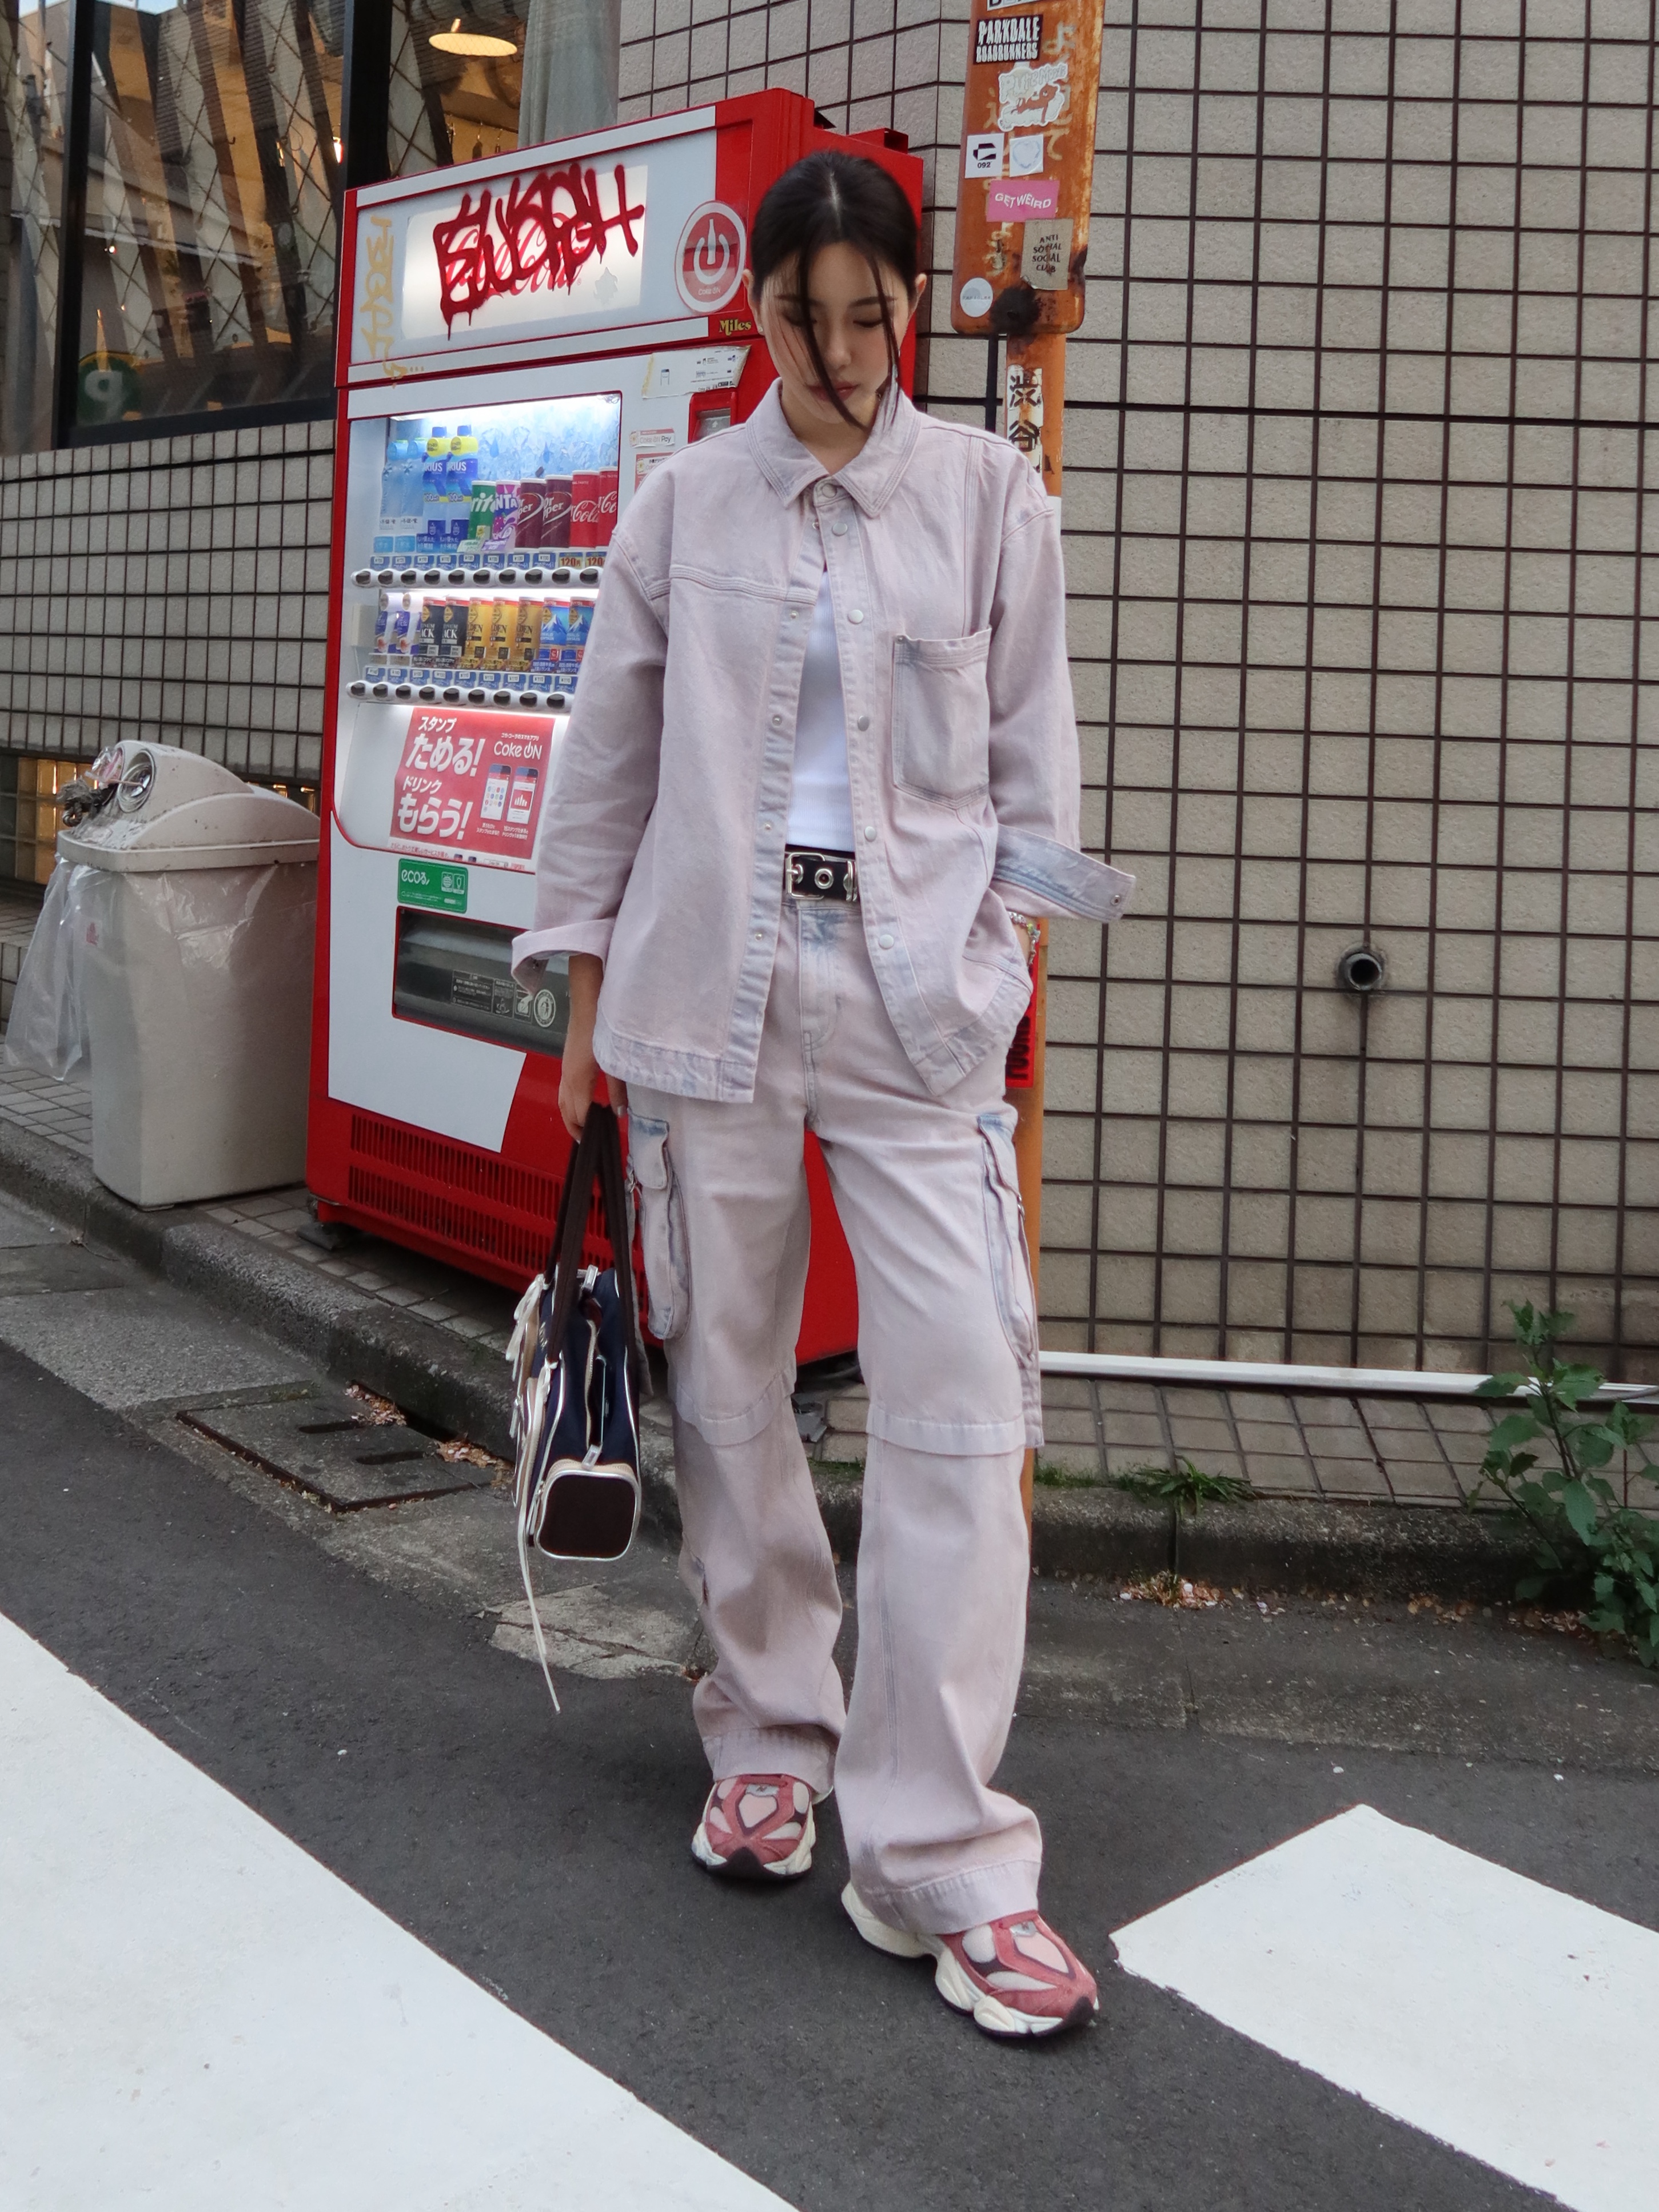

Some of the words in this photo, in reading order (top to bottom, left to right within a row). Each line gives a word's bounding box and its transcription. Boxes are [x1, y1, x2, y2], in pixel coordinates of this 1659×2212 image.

[978, 16, 1040, 45] PARKDALE
[976, 42, 1038, 63] ROADRUNNERS
[995, 193, 1016, 208] GET
[1016, 192, 1052, 209] WEIRD
[1033, 243, 1062, 253] SOIAL
[1039, 234, 1059, 244] ANTI
[1032, 253, 1060, 262] SOCAL
[719, 318, 752, 336] Miles
[418, 716, 457, 733] スタンプ
[405, 733, 485, 777] ためる!
[494, 741, 523, 758] Coke
[524, 740, 543, 760] ON
[402, 775, 442, 795] ドリンク
[397, 793, 473, 841] もらう!
